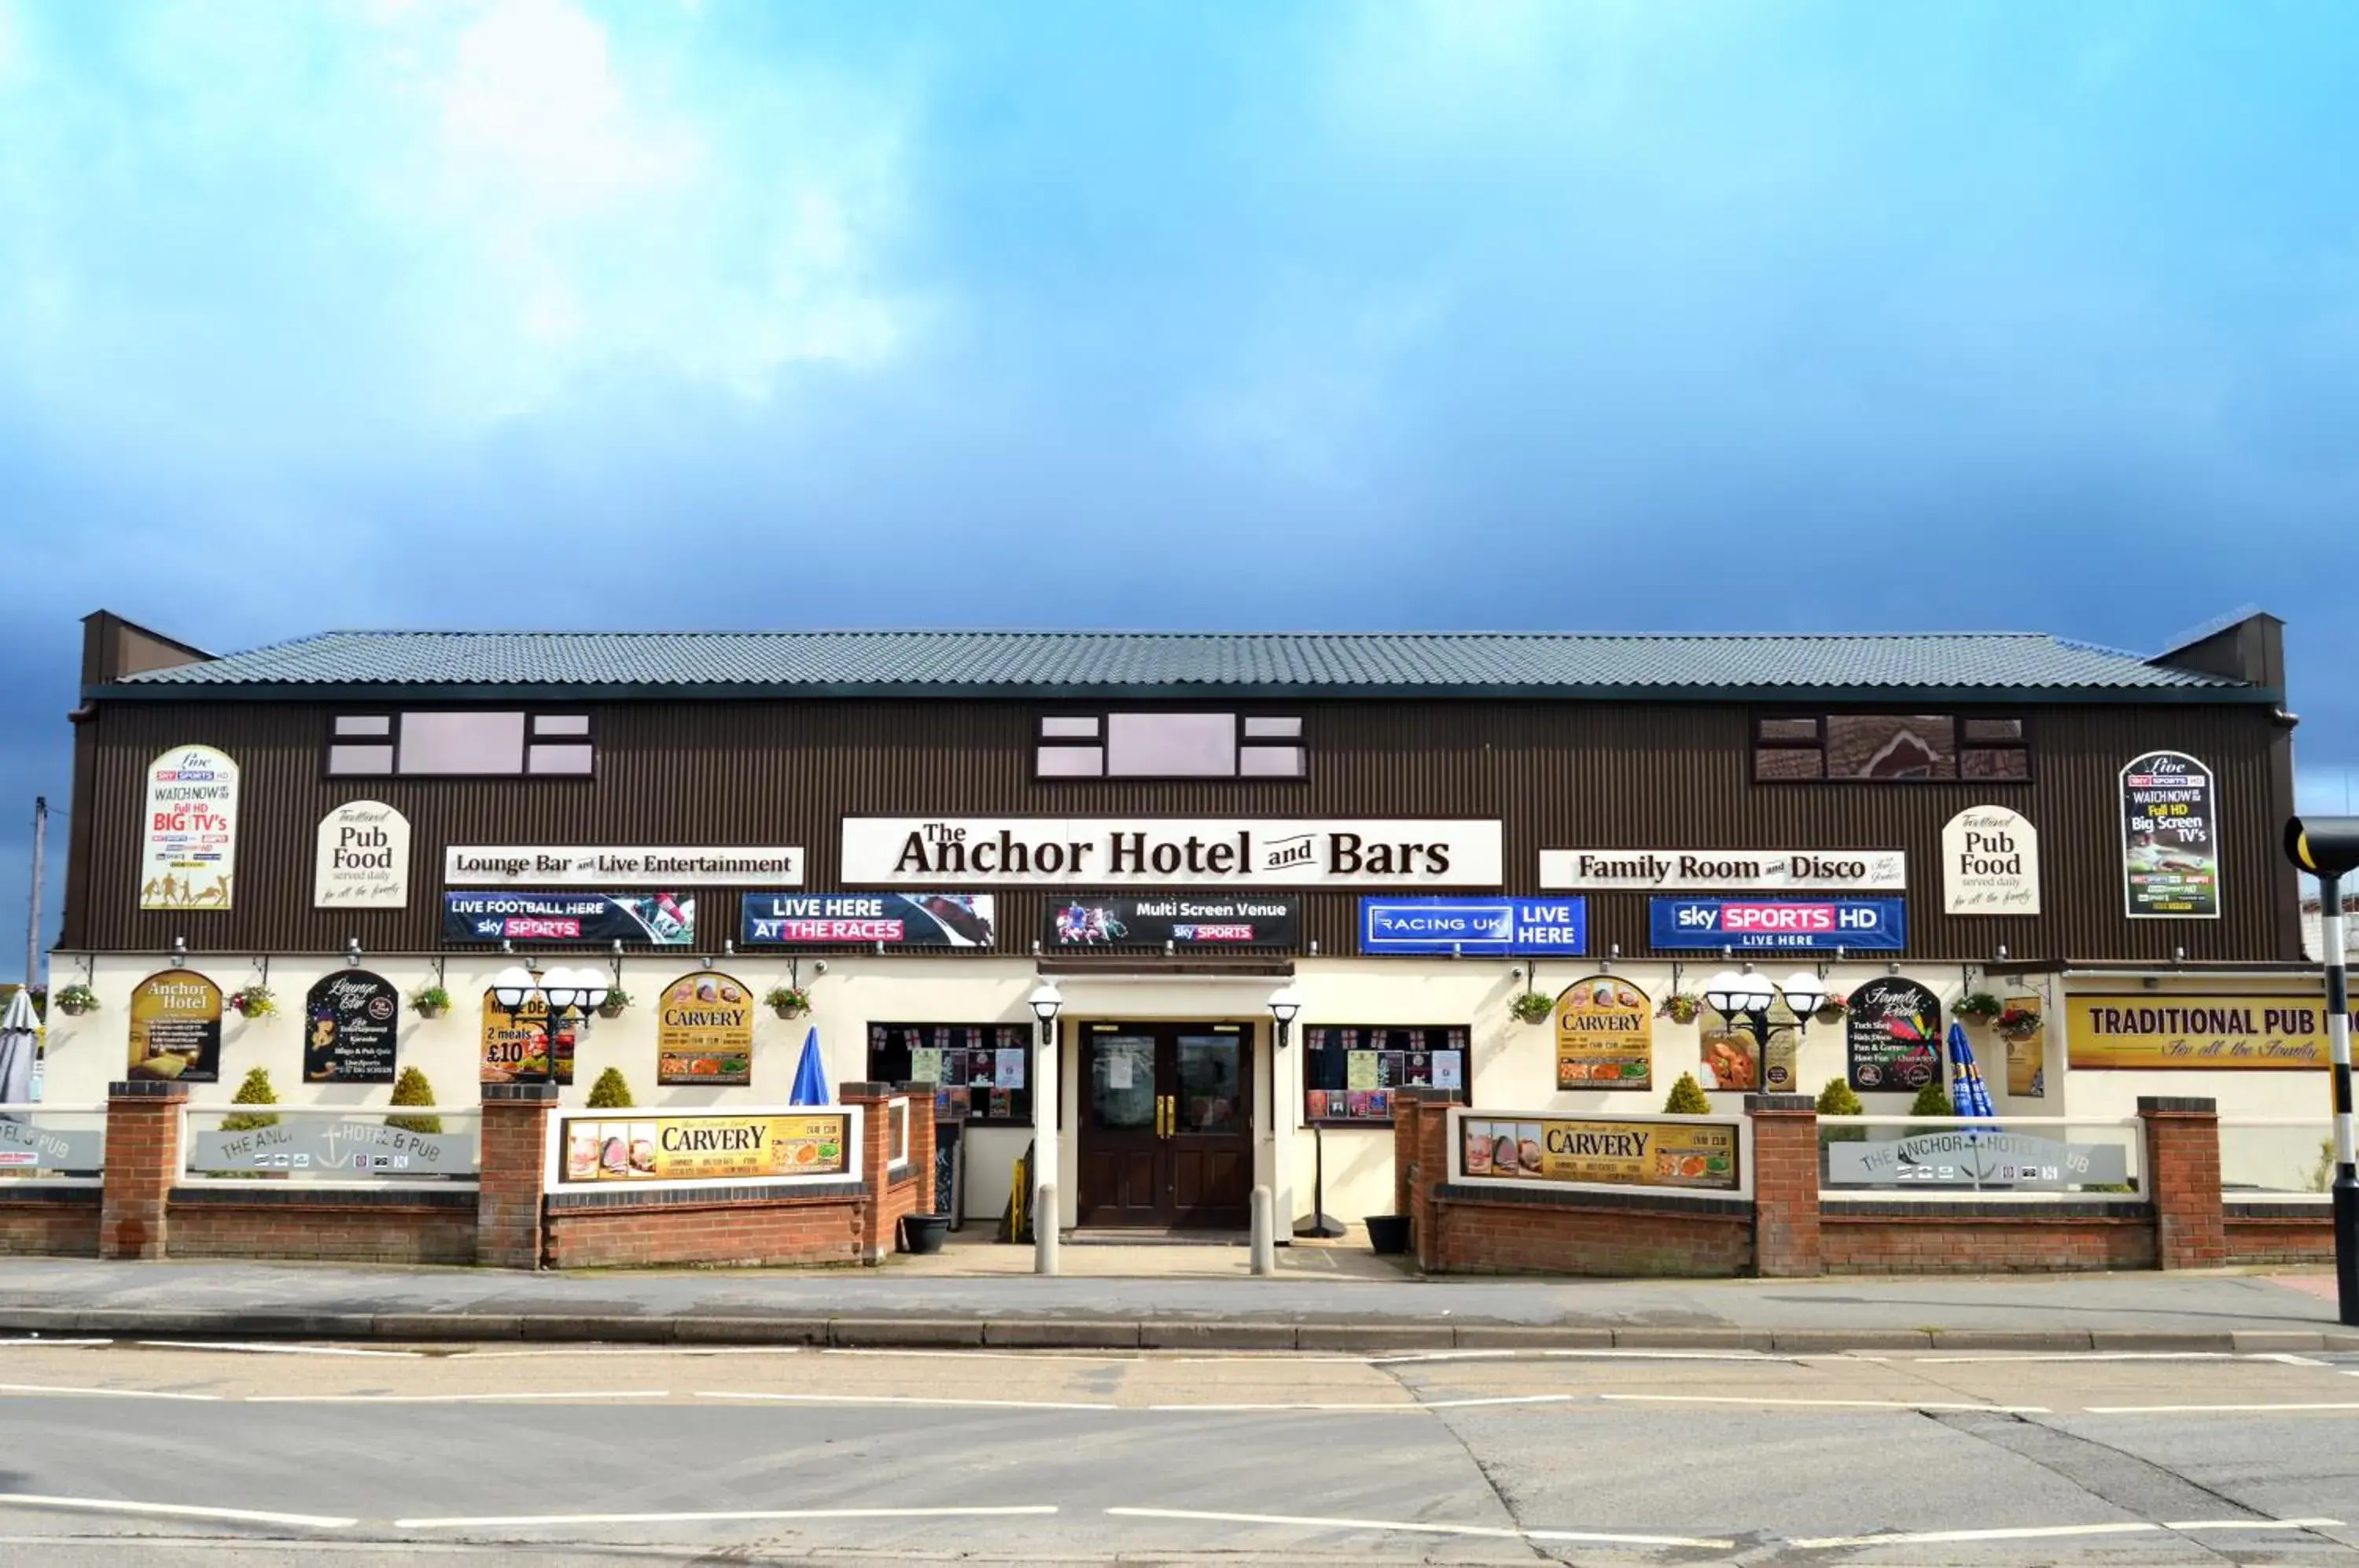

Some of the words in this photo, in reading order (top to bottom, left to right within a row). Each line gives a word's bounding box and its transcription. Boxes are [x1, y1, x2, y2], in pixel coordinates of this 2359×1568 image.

[2145, 756, 2186, 776] Live
[2152, 777, 2187, 786] SPORTS
[155, 787, 191, 801] WATCH
[192, 786, 219, 800] NOW
[2133, 791, 2167, 804] WATCH
[2167, 790, 2192, 803] NOW
[175, 803, 190, 813] Full
[193, 803, 208, 812] HD
[2148, 804, 2168, 816] Full
[2171, 804, 2188, 815] HD
[153, 812, 185, 830] BIG
[192, 814, 226, 830] TV's
[2132, 816, 2155, 833] Big
[2158, 816, 2202, 829] Screen
[340, 826, 388, 847] Pub
[923, 823, 966, 841] The
[2177, 829, 2206, 843] TV's
[1965, 831, 2015, 853] Pub
[333, 847, 392, 869] Food
[893, 830, 1094, 874] Anchor
[1110, 831, 1253, 874] Hotel
[1268, 840, 1312, 867] and
[1328, 833, 1451, 874] Bars
[456, 855, 530, 875] Lounge
[536, 855, 572, 871] Bar
[576, 858, 594, 870] and
[598, 856, 639, 871] Live
[643, 856, 792, 872] Entertainment
[1579, 855, 1672, 883] Family
[1680, 856, 1761, 878] Room
[1765, 862, 1786, 874] and
[1791, 856, 1866, 878] Disco
[1960, 853, 2022, 875] Food
[333, 871, 365, 880] served
[367, 870, 390, 882] daily
[1963, 878, 1995, 887] served
[1997, 877, 2020, 889] daily
[452, 901, 484, 913] LIVE
[487, 901, 563, 915] FOOTBALL
[567, 903, 605, 915] HERE
[773, 899, 820, 917] LIVE
[826, 900, 882, 917] HERE
[1136, 902, 1177, 917] Multi
[1180, 903, 1234, 917] Screen
[1236, 902, 1287, 917] Venue
[1522, 906, 1570, 923] LIVE
[1380, 918, 1465, 931] RACING
[1474, 918, 1503, 931] UK
[1678, 909, 1717, 929] sky
[1725, 908, 1832, 929] SPORTS
[1840, 910, 1878, 929] HD
[477, 920, 504, 936] sky
[508, 922, 576, 935] SPORTS
[755, 922, 784, 937] AT
[790, 922, 826, 937] THE
[832, 922, 900, 938] RACES
[1174, 926, 1194, 940] sky
[1198, 926, 1252, 938] SPORTS
[1519, 928, 1575, 944] HERE
[1743, 936, 1774, 946] LIVE
[1778, 936, 1813, 946] HERE
[148, 981, 208, 996] Anchor
[328, 977, 378, 999] Lounge
[1865, 986, 1923, 1007] Family
[163, 995, 208, 1010] Hotel
[664, 1009, 745, 1026] CARVERY
[1562, 1014, 1643, 1031] CARVERY
[2089, 1007, 2258, 1035] TRADITIONAL
[2265, 1009, 2316, 1036] PUB
[488, 1027, 495, 1040] 2
[498, 1025, 532, 1040] meals
[487, 1042, 523, 1062] £10
[2162, 1039, 2192, 1058] For
[2198, 1040, 2225, 1058] all
[2229, 1041, 2253, 1058] the
[2258, 1039, 2320, 1059] Family
[38, 1134, 69, 1159] PUB
[662, 1125, 767, 1151] CARVERY
[1547, 1128, 1648, 1156] CARVERY
[221, 1137, 252, 1160] THE
[394, 1133, 405, 1148] &
[409, 1137, 440, 1162] PUB
[1860, 1148, 1893, 1171] THE
[1898, 1136, 1963, 1159] ANCHOR
